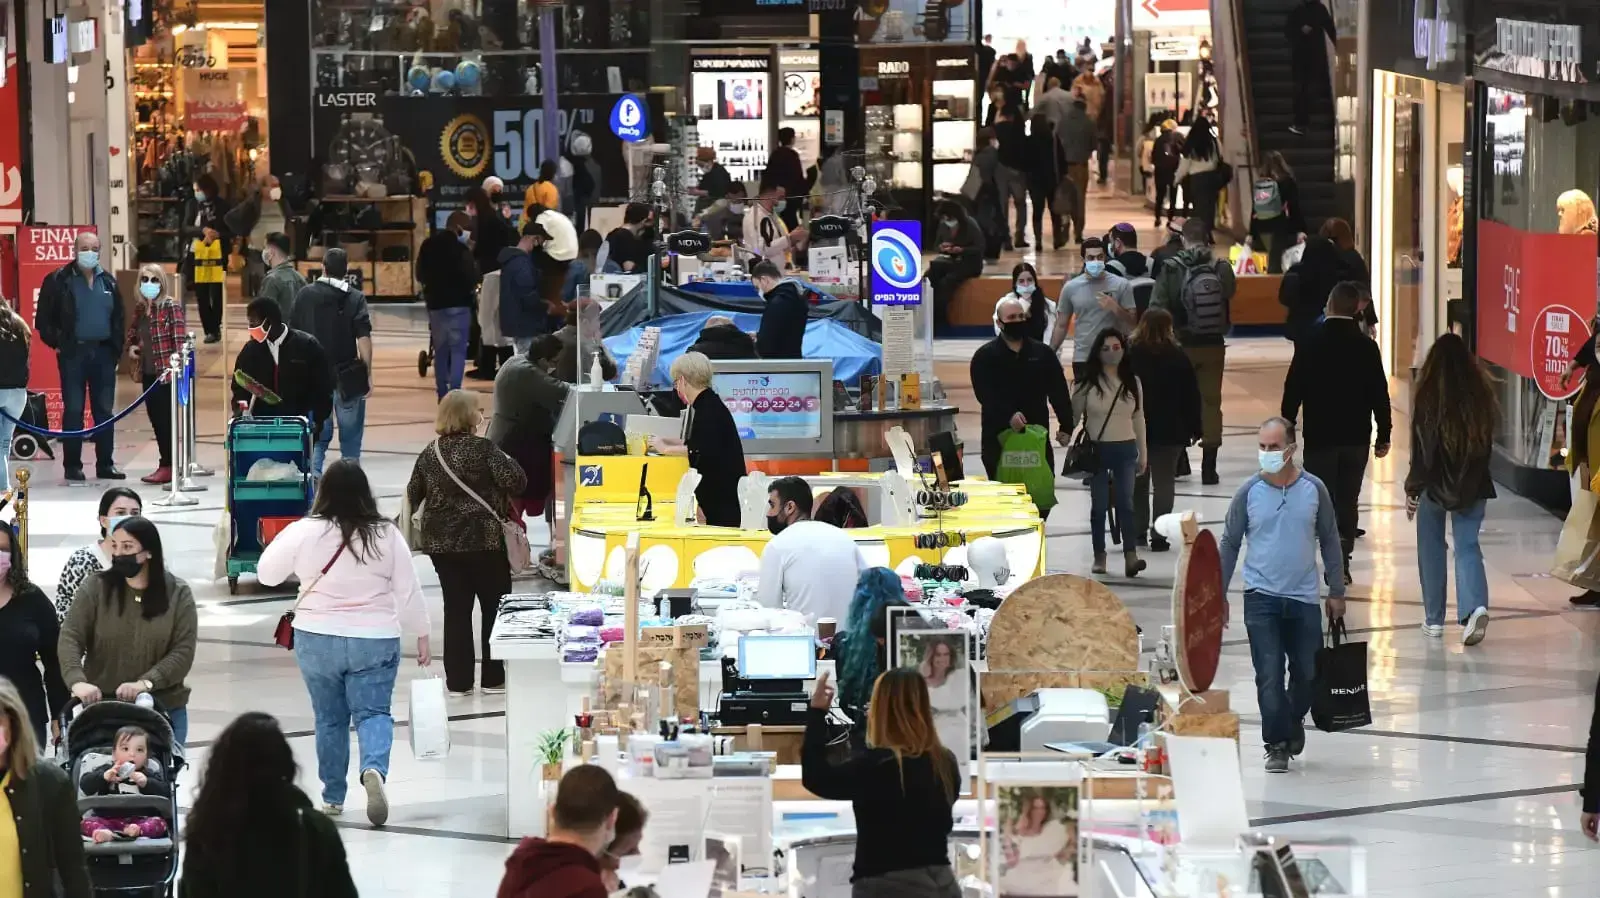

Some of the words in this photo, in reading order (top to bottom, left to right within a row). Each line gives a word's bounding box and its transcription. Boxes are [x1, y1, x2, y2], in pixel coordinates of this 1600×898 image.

[878, 61, 909, 73] RADO
[200, 72, 229, 80] HUGE
[319, 92, 377, 107] LASTER
[678, 239, 702, 247] MOYA
[895, 292, 920, 302] מפעל
[756, 400, 769, 408] 28
[772, 400, 785, 408] 22
[788, 400, 800, 408] 24
[807, 400, 814, 408] 5
